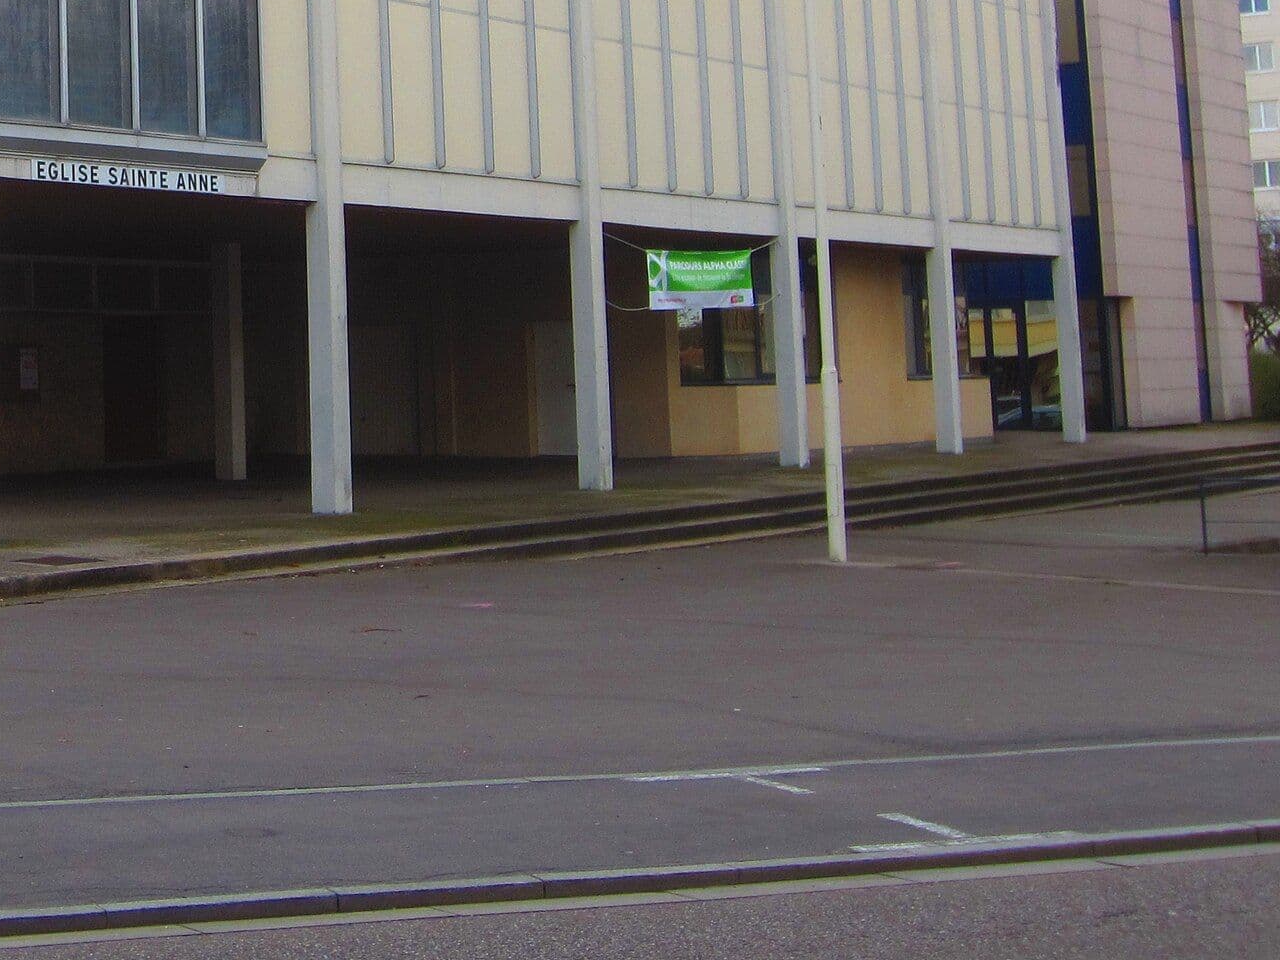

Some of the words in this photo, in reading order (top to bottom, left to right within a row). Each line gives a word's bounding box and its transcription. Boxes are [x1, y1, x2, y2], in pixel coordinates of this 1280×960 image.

[37, 161, 100, 183] EGLISE
[108, 167, 168, 189] SAINTE
[177, 172, 219, 192] ANNE
